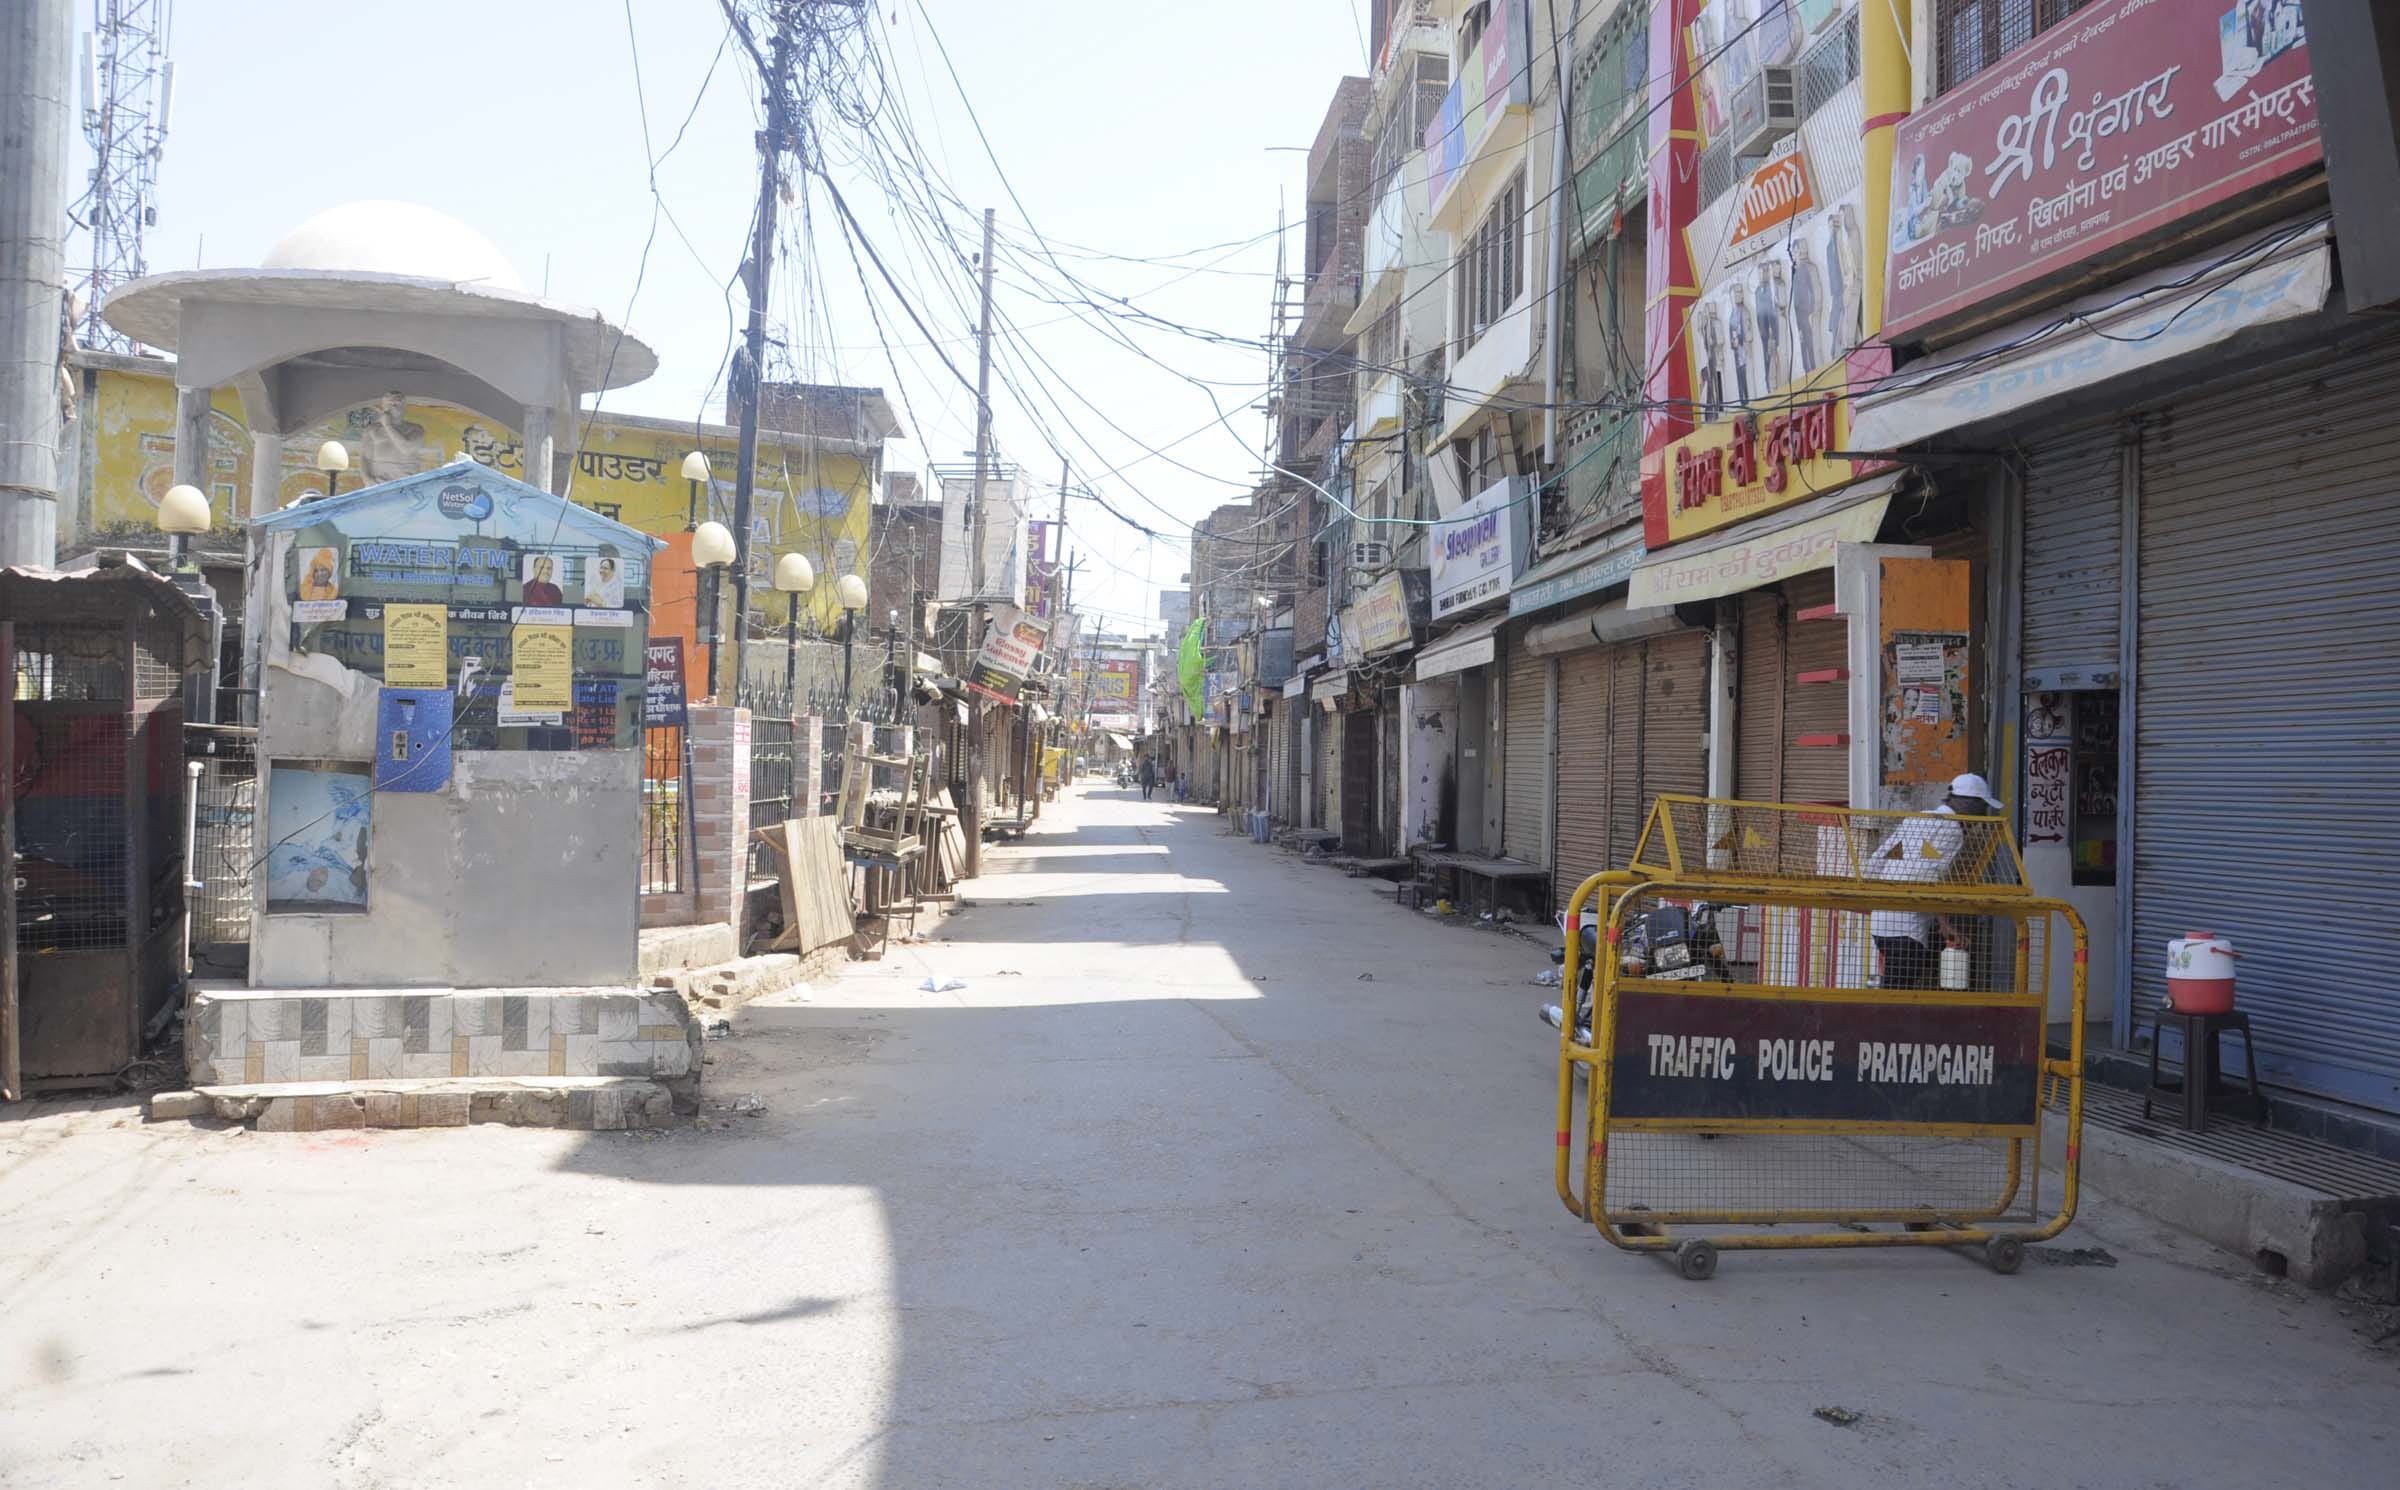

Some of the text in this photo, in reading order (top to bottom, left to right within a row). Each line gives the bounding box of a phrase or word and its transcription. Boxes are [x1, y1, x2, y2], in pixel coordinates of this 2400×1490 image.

[1984, 67, 2069, 199] श्री
[2028, 178, 2098, 235] खिलौना
[2100, 154, 2131, 200] एवं
[2133, 130, 2198, 185] अण्डर
[1763, 392, 1838, 494] दुकान
[577, 451, 668, 484] पाउडर
[443, 491, 474, 503] NetSol
[359, 543, 510, 569] WATER ATM
[1755, 529, 1839, 580] दुकान
[2030, 779, 2067, 808] ब्यूटी
[2032, 805, 2066, 830] पार्लर
[1648, 1034, 1995, 1086] TRAFFIC POLICE PRATAPGARH
